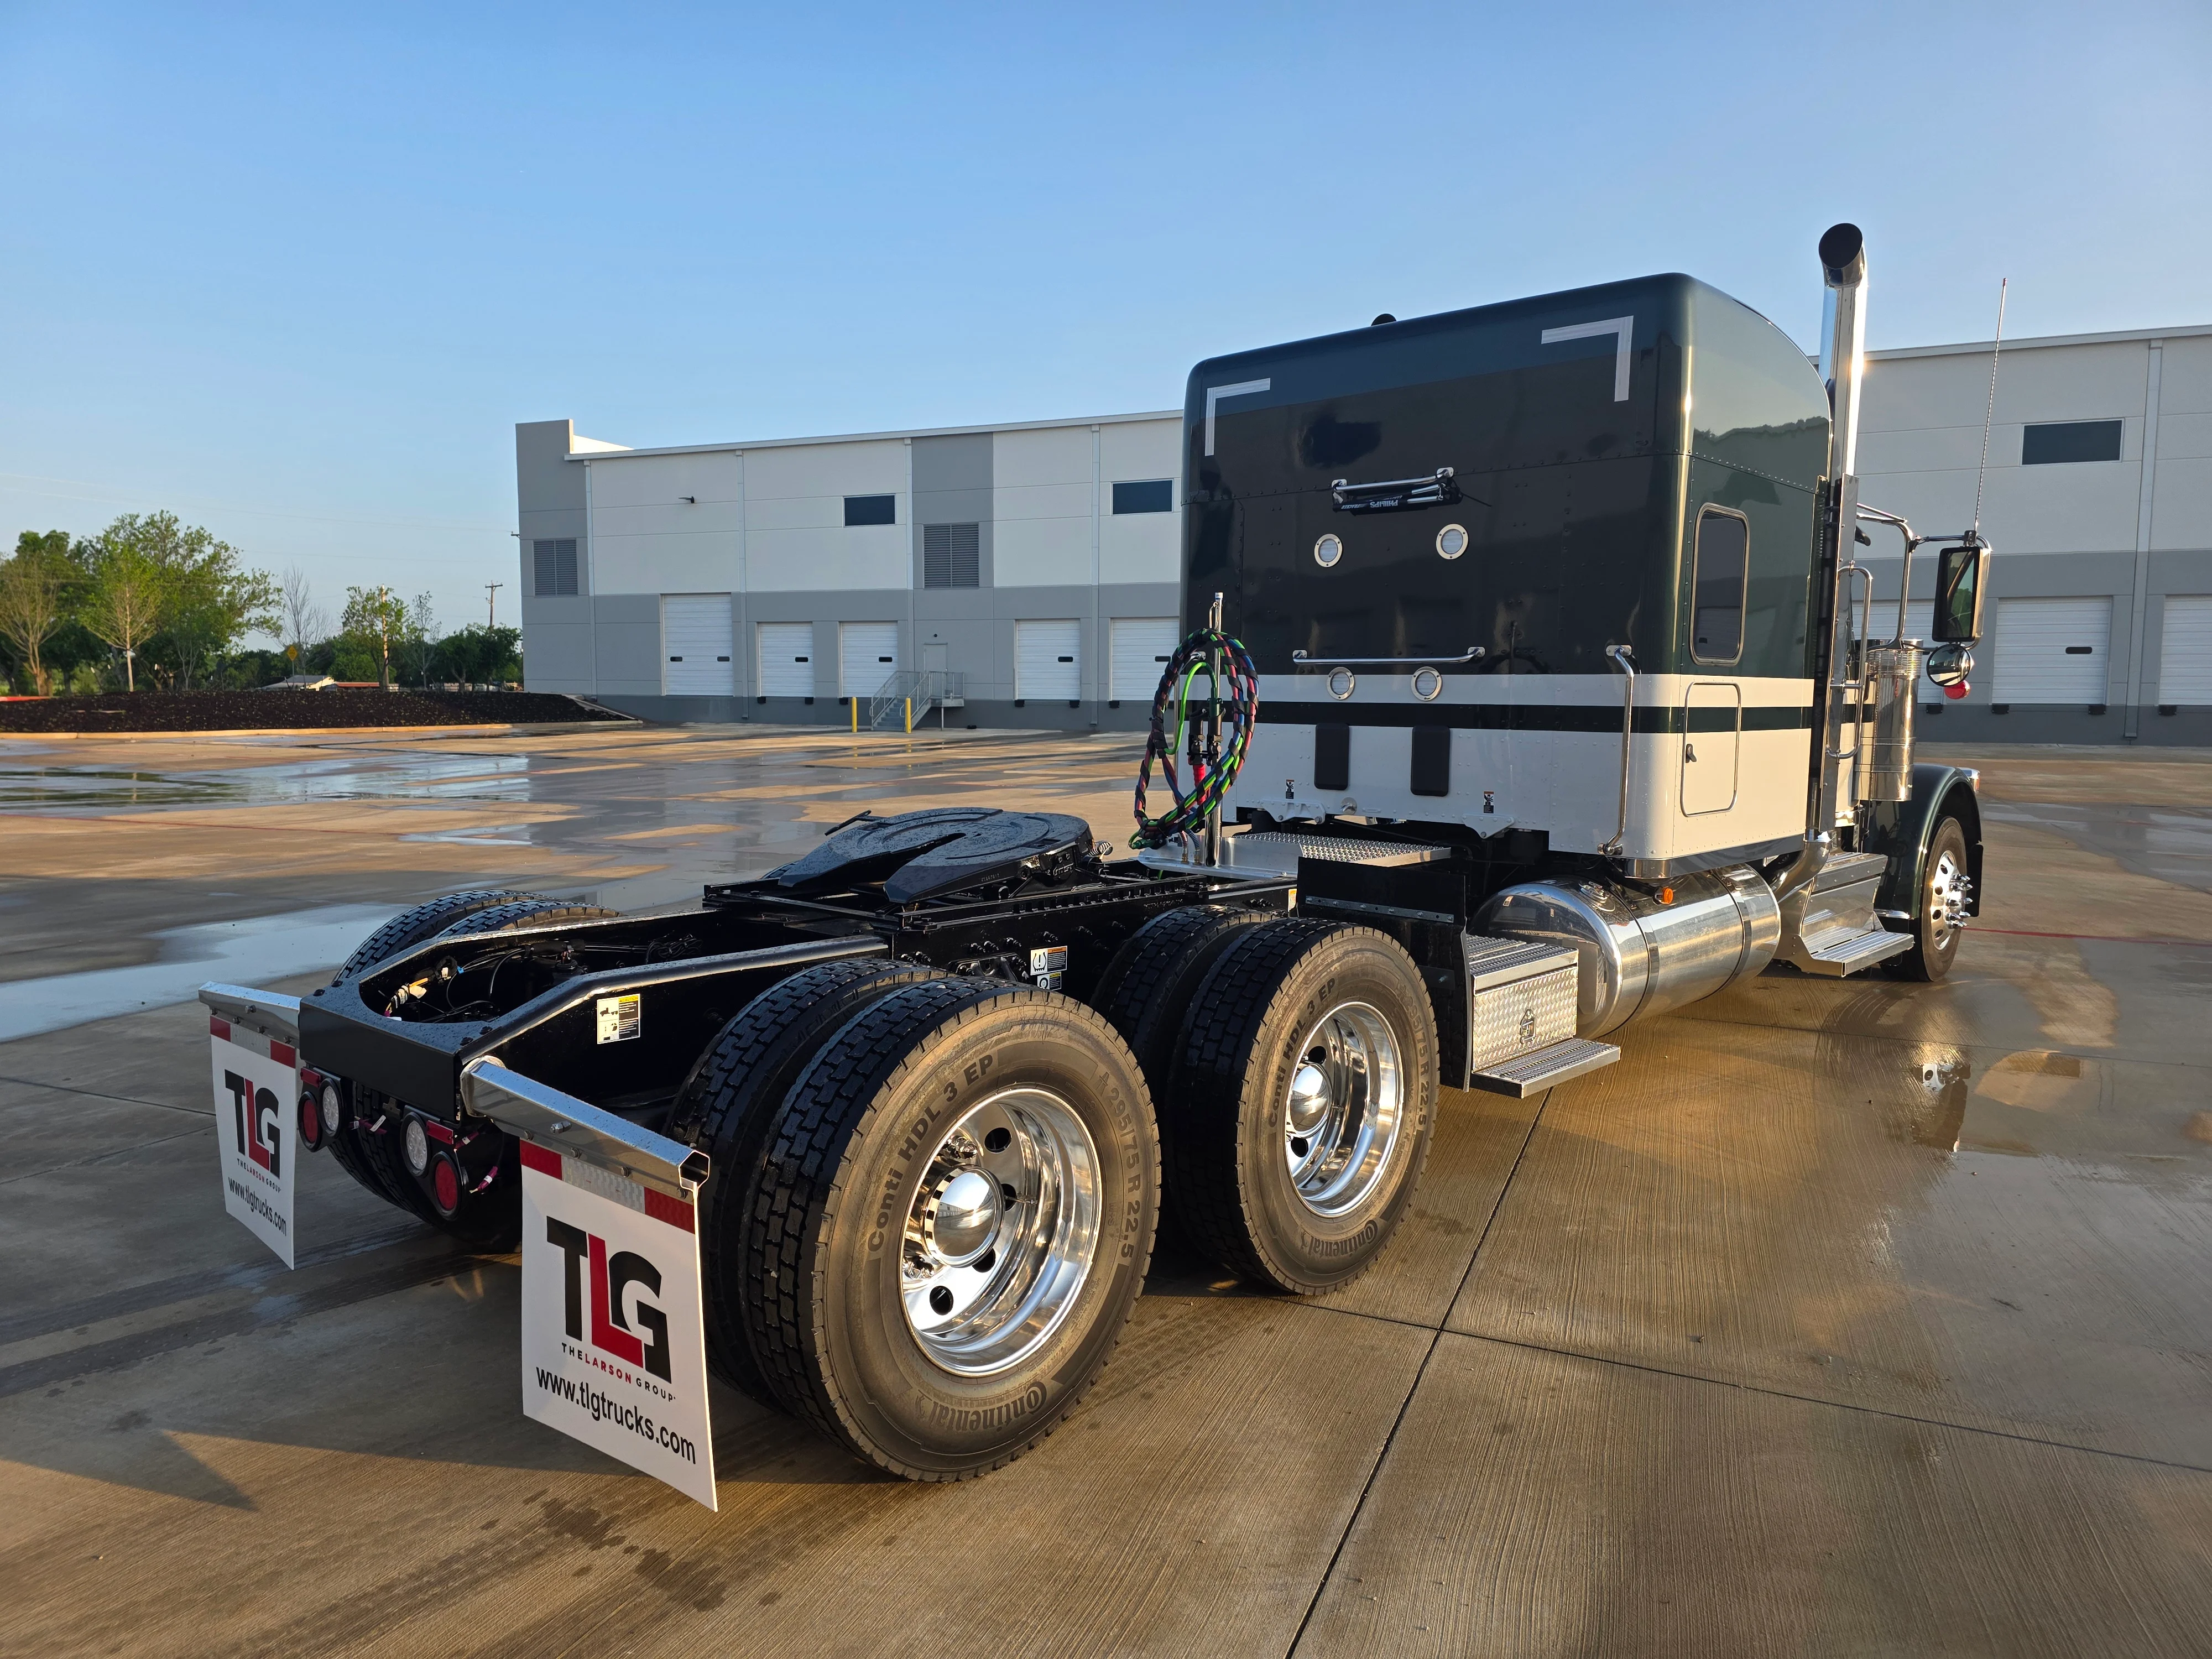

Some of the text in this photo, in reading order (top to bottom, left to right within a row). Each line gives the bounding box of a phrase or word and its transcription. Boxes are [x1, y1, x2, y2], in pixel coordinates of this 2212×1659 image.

[1370, 499, 1399, 508] PHILLIPS
[1269, 978, 1335, 1128] Conti HDL 3 EP
[1420, 1064, 1430, 1076] R
[225, 1069, 280, 1180] TLG
[1418, 1081, 1430, 1126] 22.5
[867, 1054, 994, 1252] Conti HDL 3 EP
[228, 1177, 286, 1237] www.tlgtrucks.com
[266, 1178, 280, 1193] GROUP
[1128, 1178, 1141, 1193] R
[1121, 1200, 1140, 1258] 22.5
[1307, 1219, 1378, 1258] Continental
[546, 1215, 671, 1384] TLG
[536, 1366, 696, 1464] www.tlgtrucks.com
[636, 1378, 673, 1402] GROUP
[929, 1381, 1047, 1432] Continental
